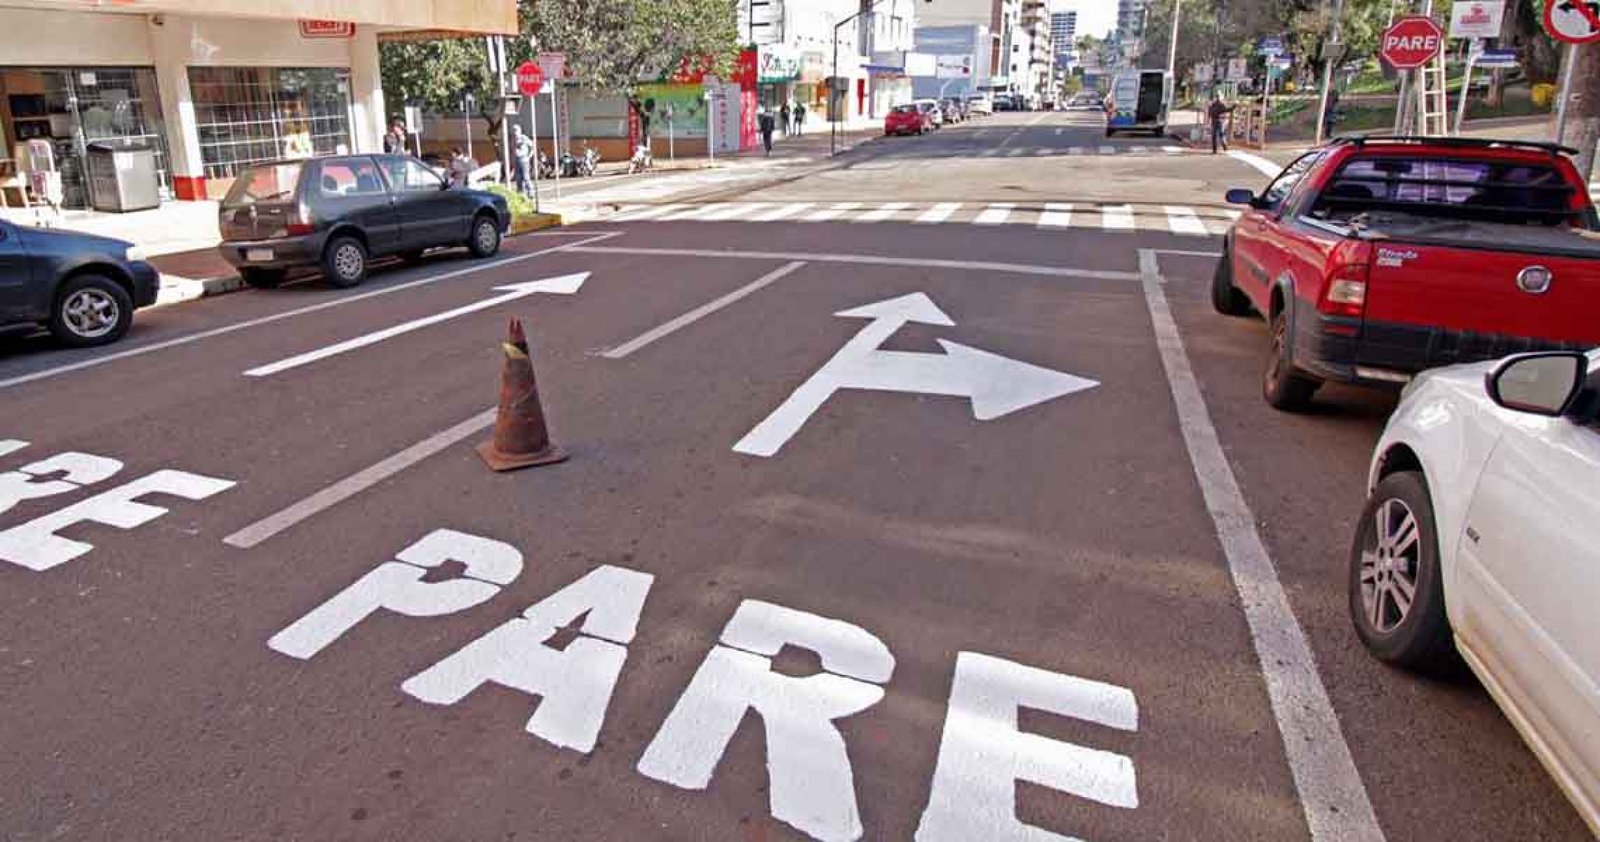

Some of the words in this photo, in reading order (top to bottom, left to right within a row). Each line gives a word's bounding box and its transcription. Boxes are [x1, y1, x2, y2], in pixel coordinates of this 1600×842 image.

[1387, 35, 1438, 51] PARE
[0, 439, 237, 572] RE
[267, 528, 1139, 842] PARE
